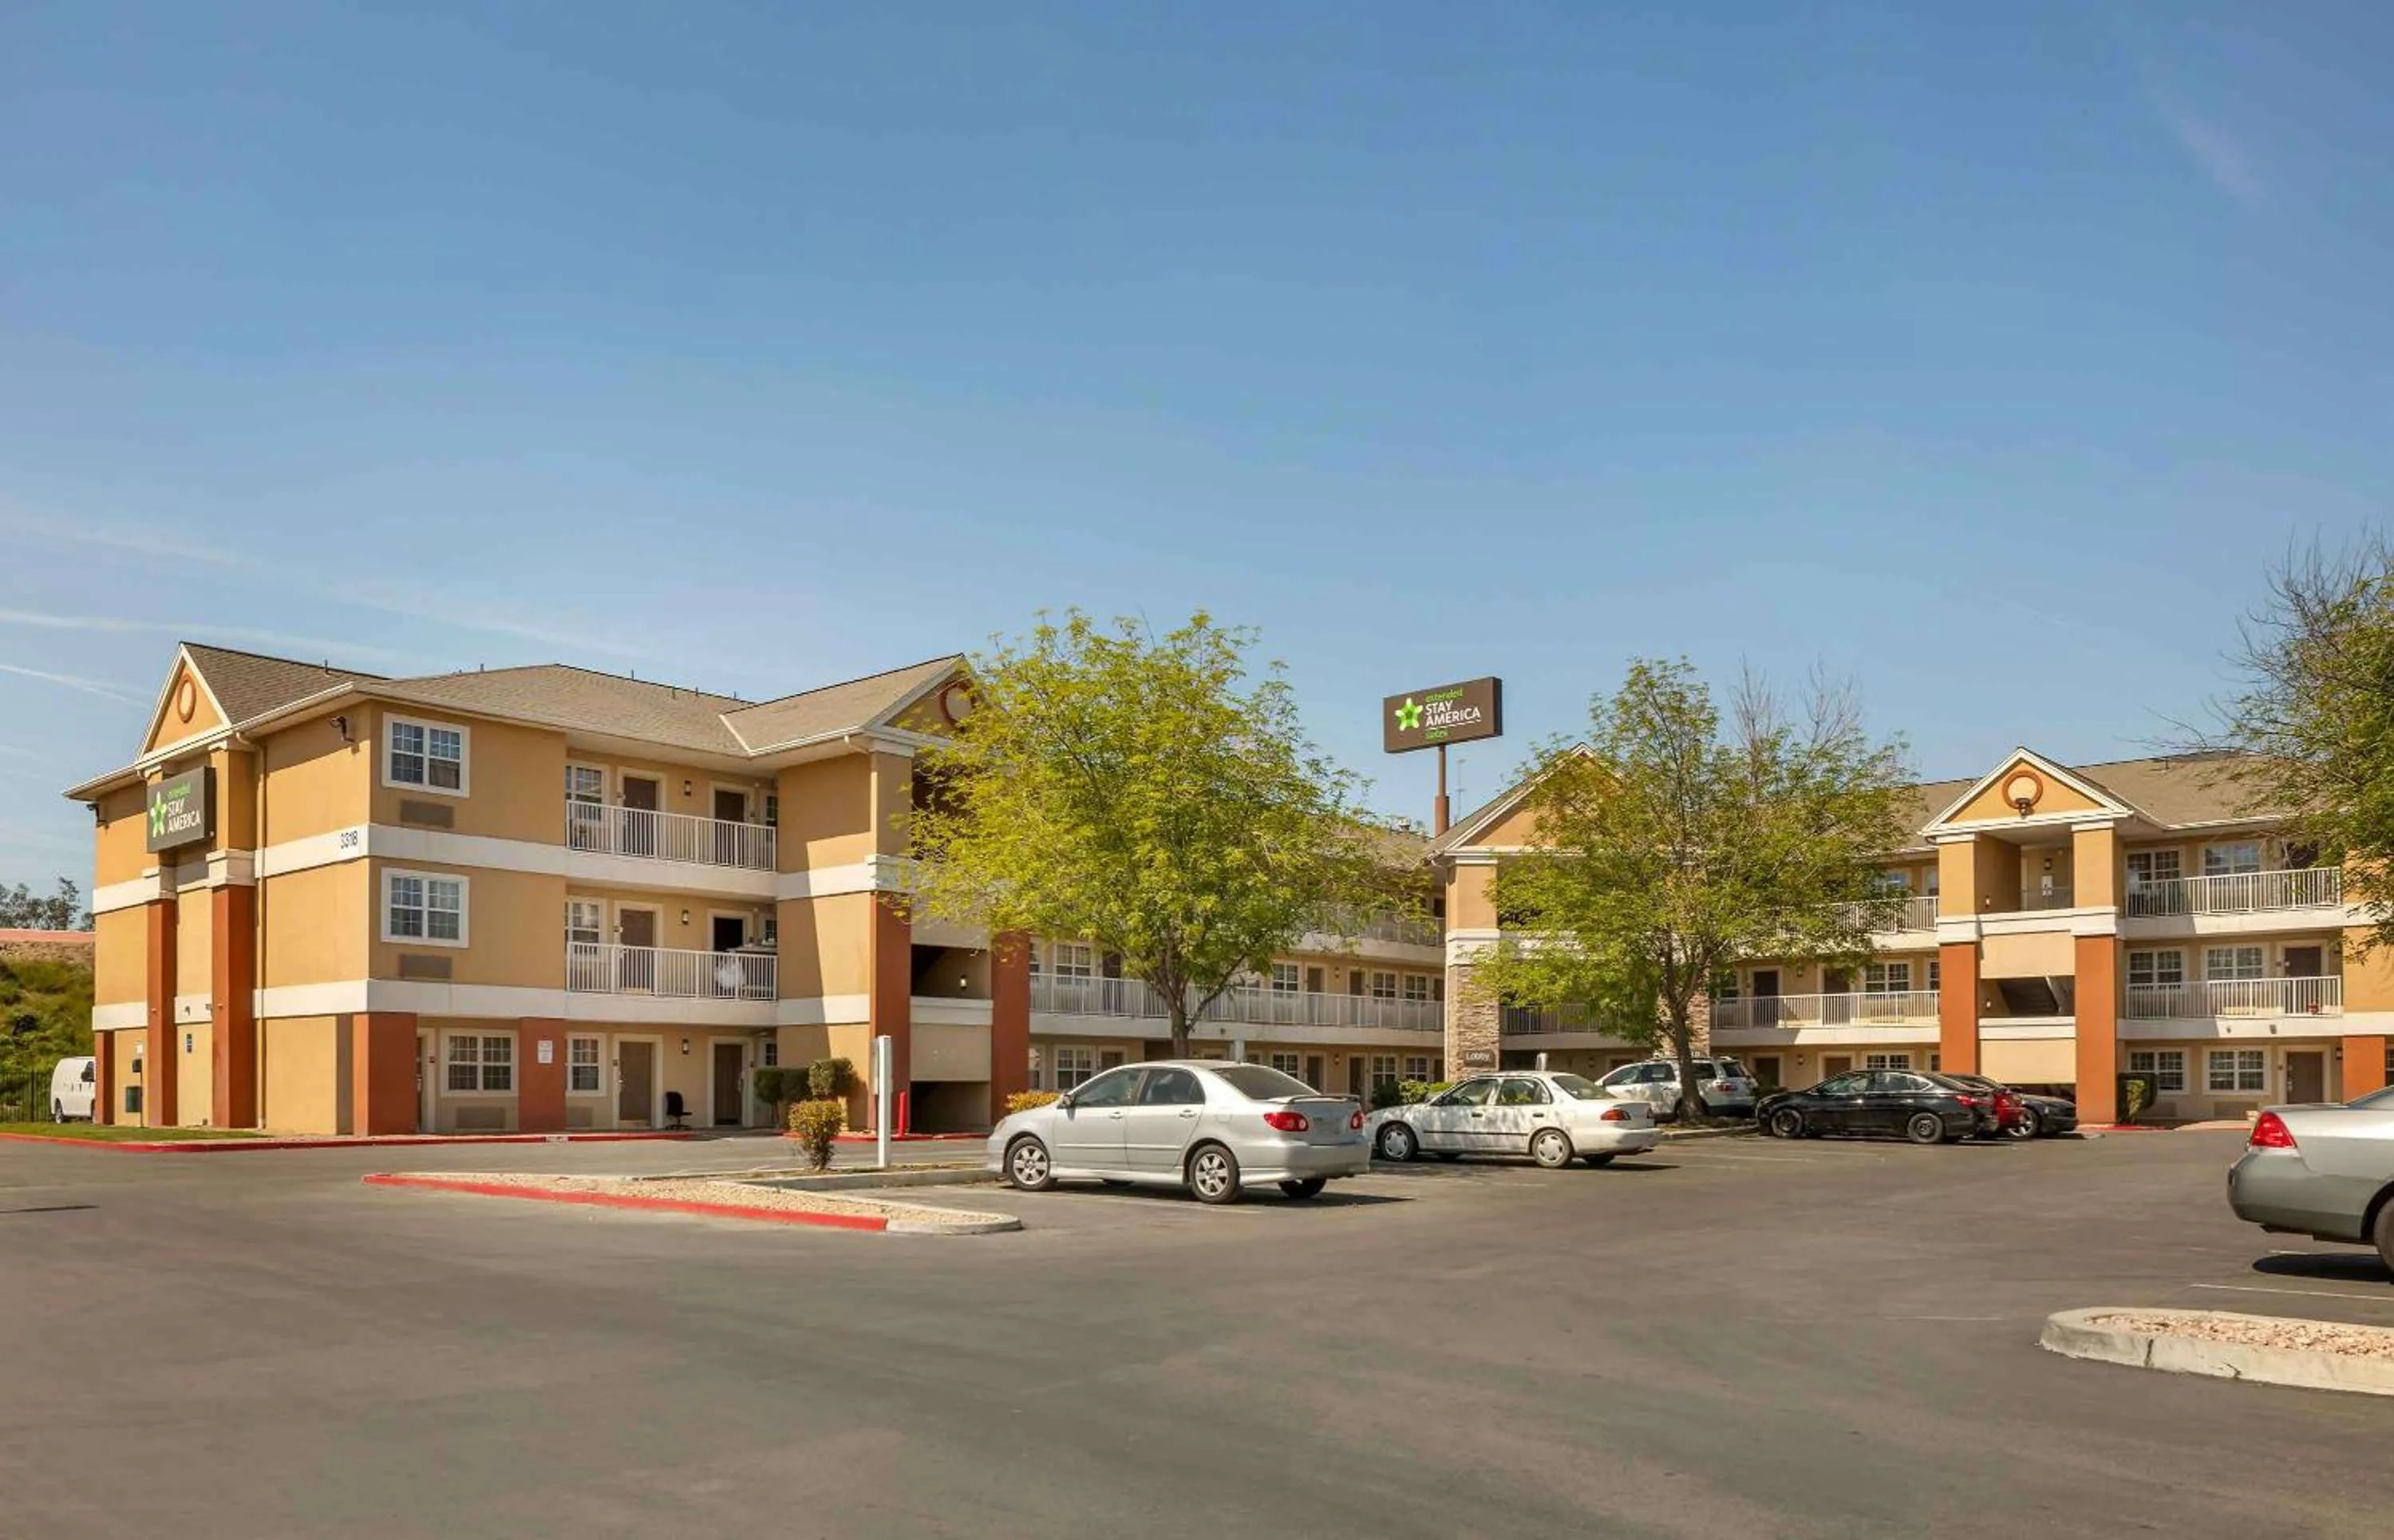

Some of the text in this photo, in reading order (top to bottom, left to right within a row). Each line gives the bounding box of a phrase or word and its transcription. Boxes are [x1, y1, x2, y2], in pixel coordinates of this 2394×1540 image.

[1425, 700, 1453, 715] STAY
[1425, 707, 1481, 727] AMERICA
[168, 797, 185, 818] STAY
[168, 809, 201, 834] AMERICA
[341, 830, 358, 849] 3318
